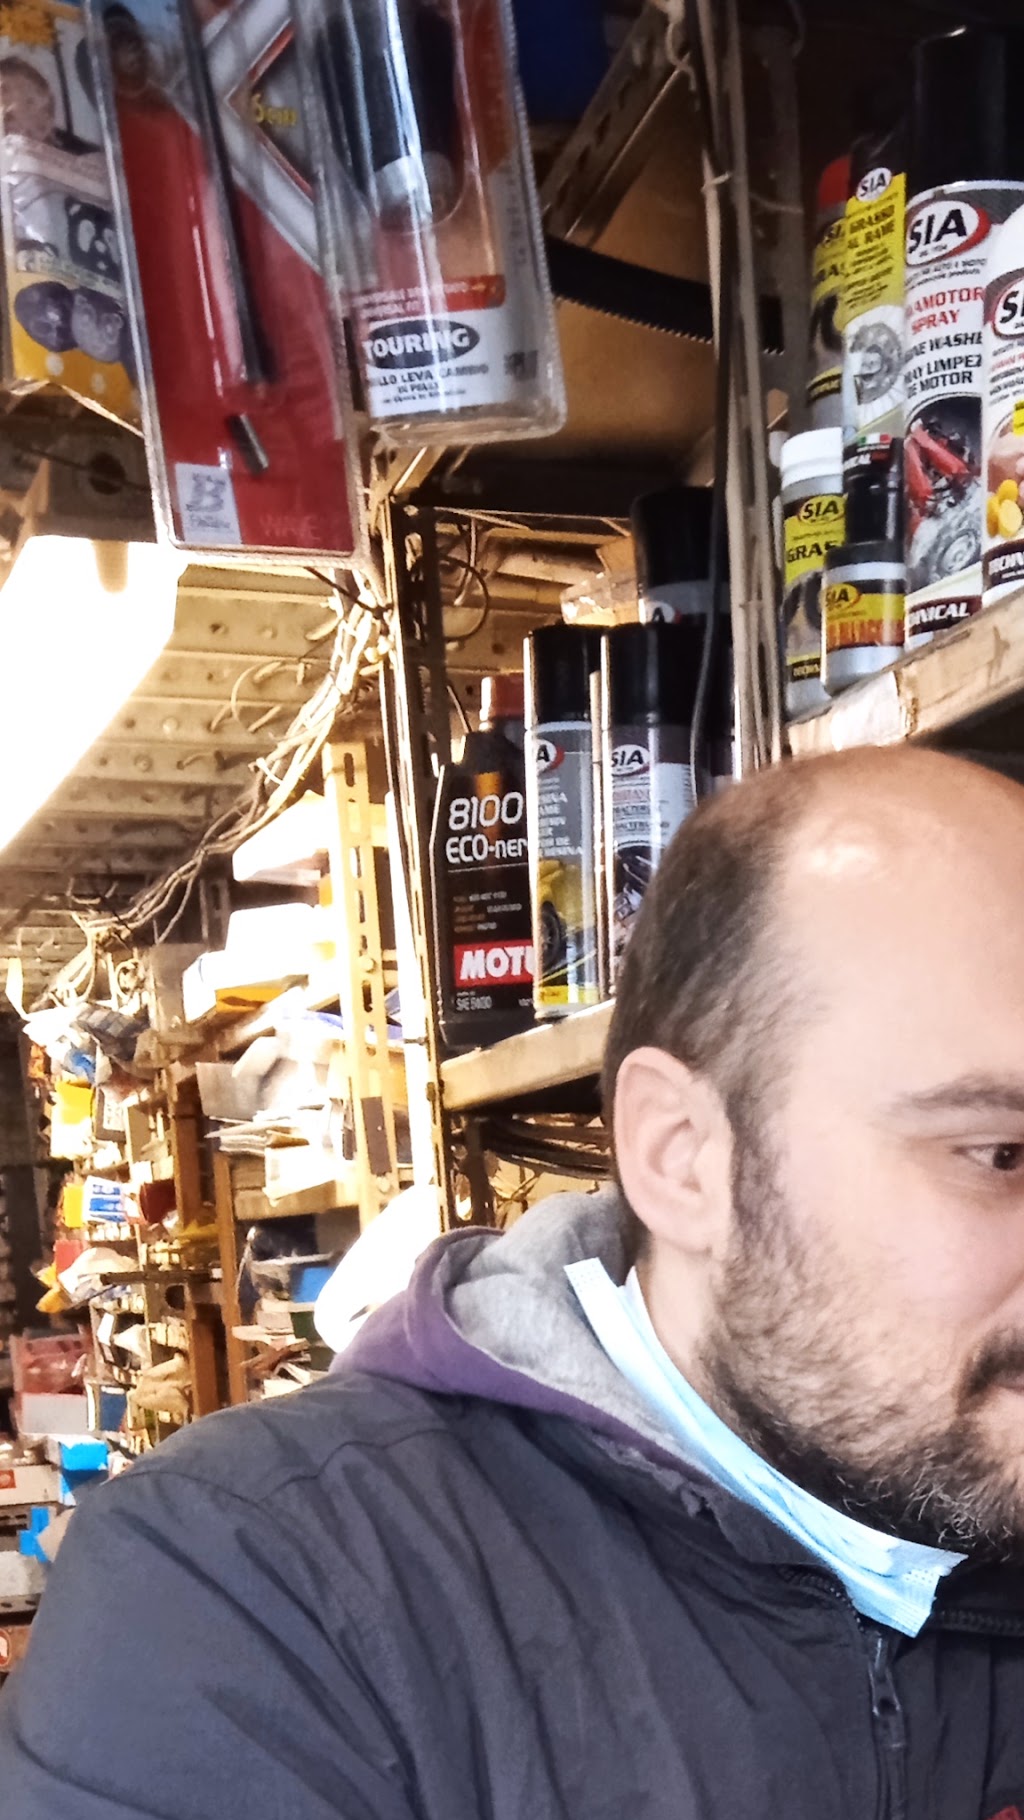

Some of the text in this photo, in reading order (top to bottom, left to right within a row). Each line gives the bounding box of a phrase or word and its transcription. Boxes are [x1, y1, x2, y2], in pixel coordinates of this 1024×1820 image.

[859, 172, 887, 198] SIA
[908, 208, 968, 254] SIA
[362, 327, 471, 361] TOURING
[919, 370, 973, 391] MOTOR
[801, 499, 840, 520] SIA
[611, 750, 645, 768] SIA
[449, 791, 524, 831] 8100
